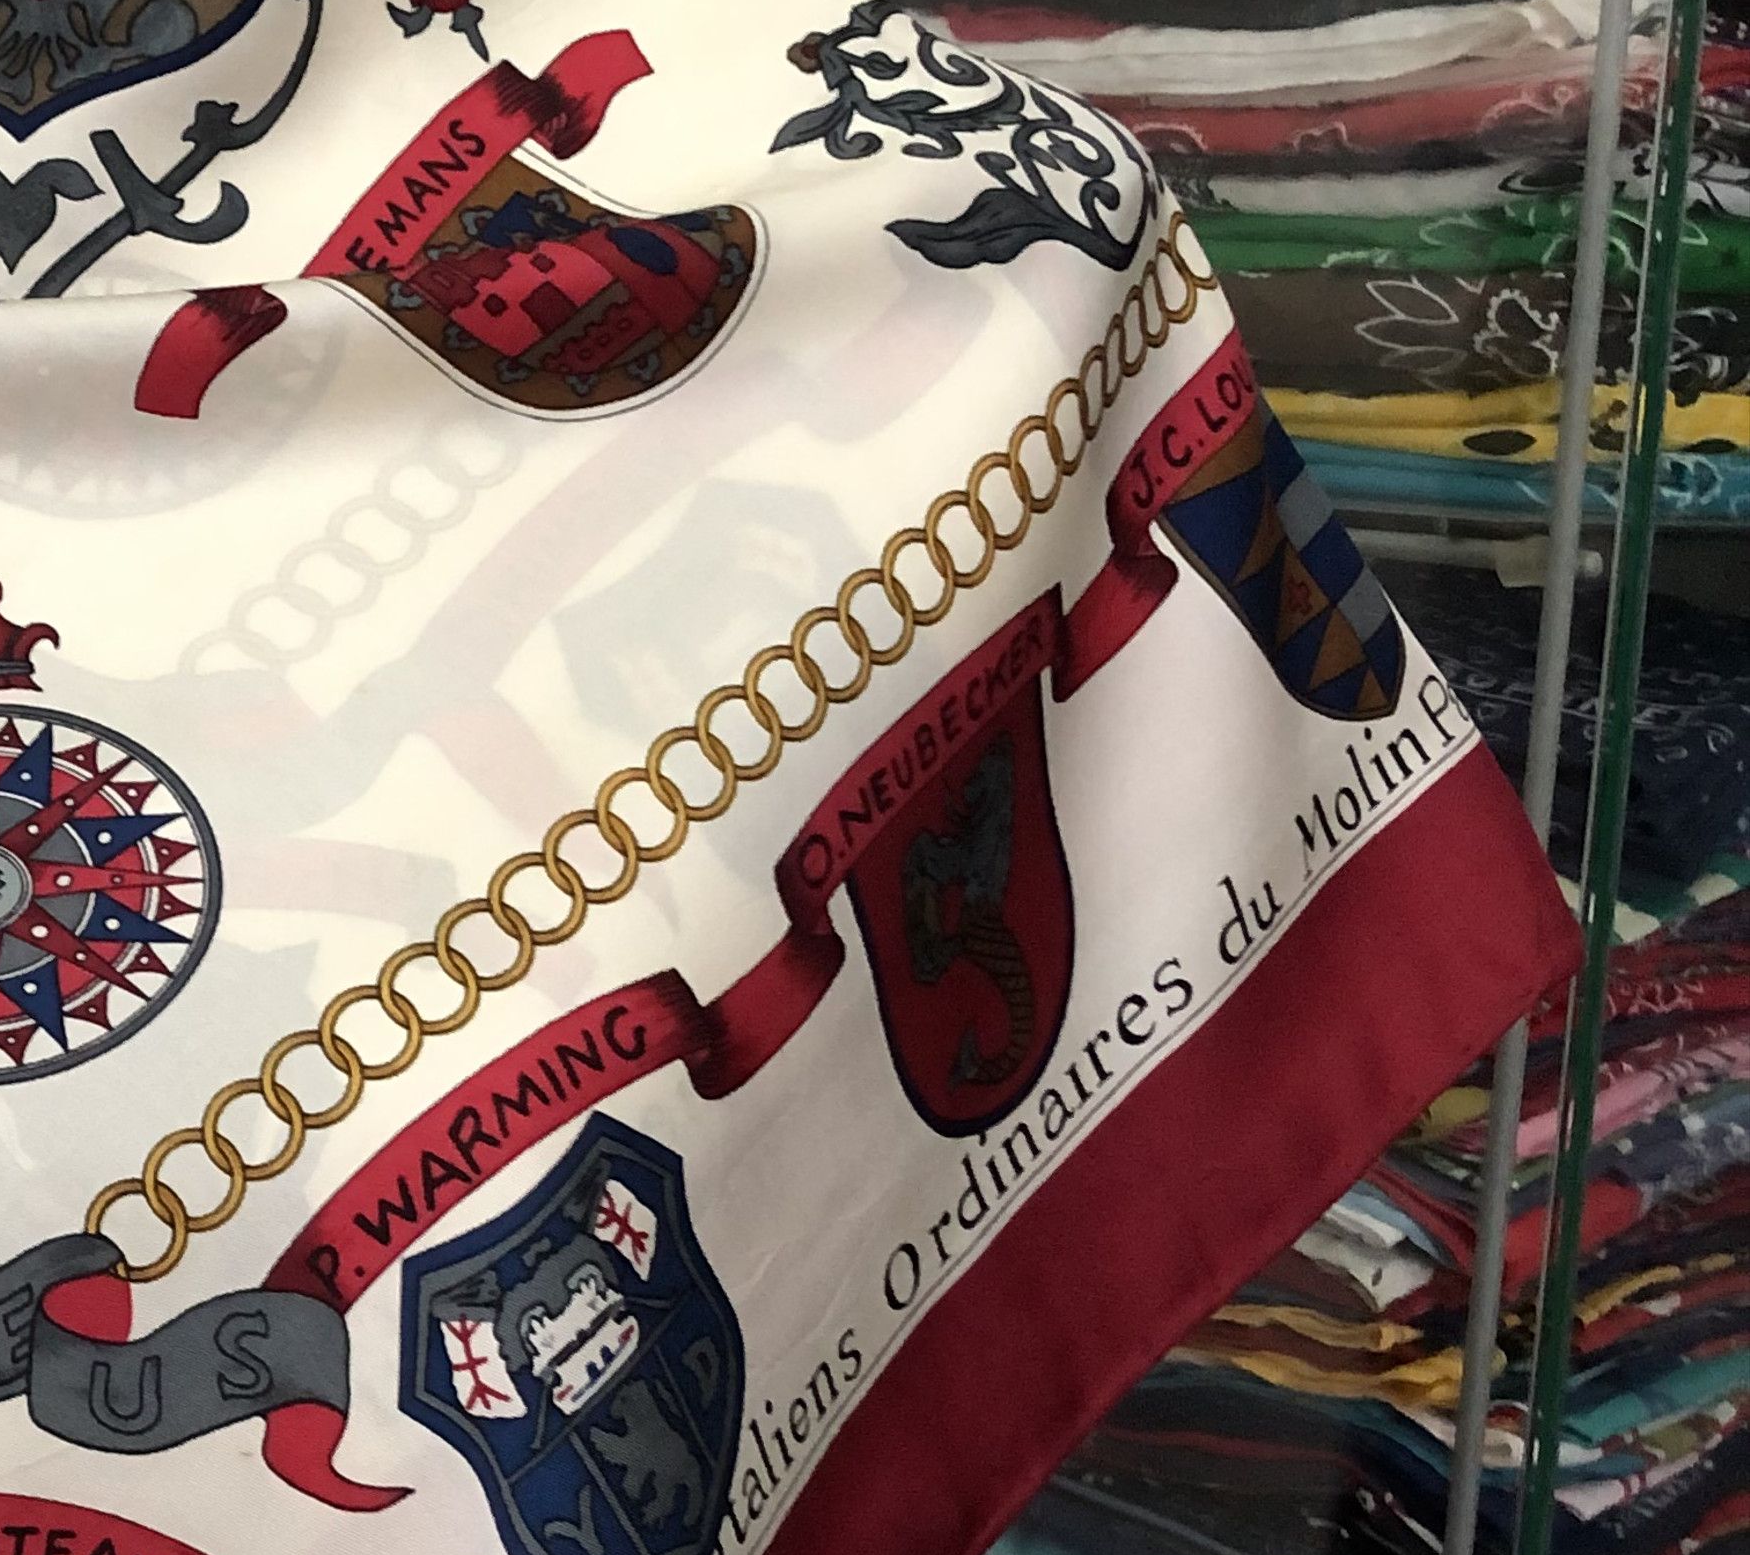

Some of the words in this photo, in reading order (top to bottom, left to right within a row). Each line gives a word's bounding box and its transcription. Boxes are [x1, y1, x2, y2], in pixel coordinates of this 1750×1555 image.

[354, 1004, 648, 1246] WARMING
[881, 958, 1195, 1310] Ordinaires
[1216, 875, 1285, 966] du
[1294, 726, 1433, 883] Molin
